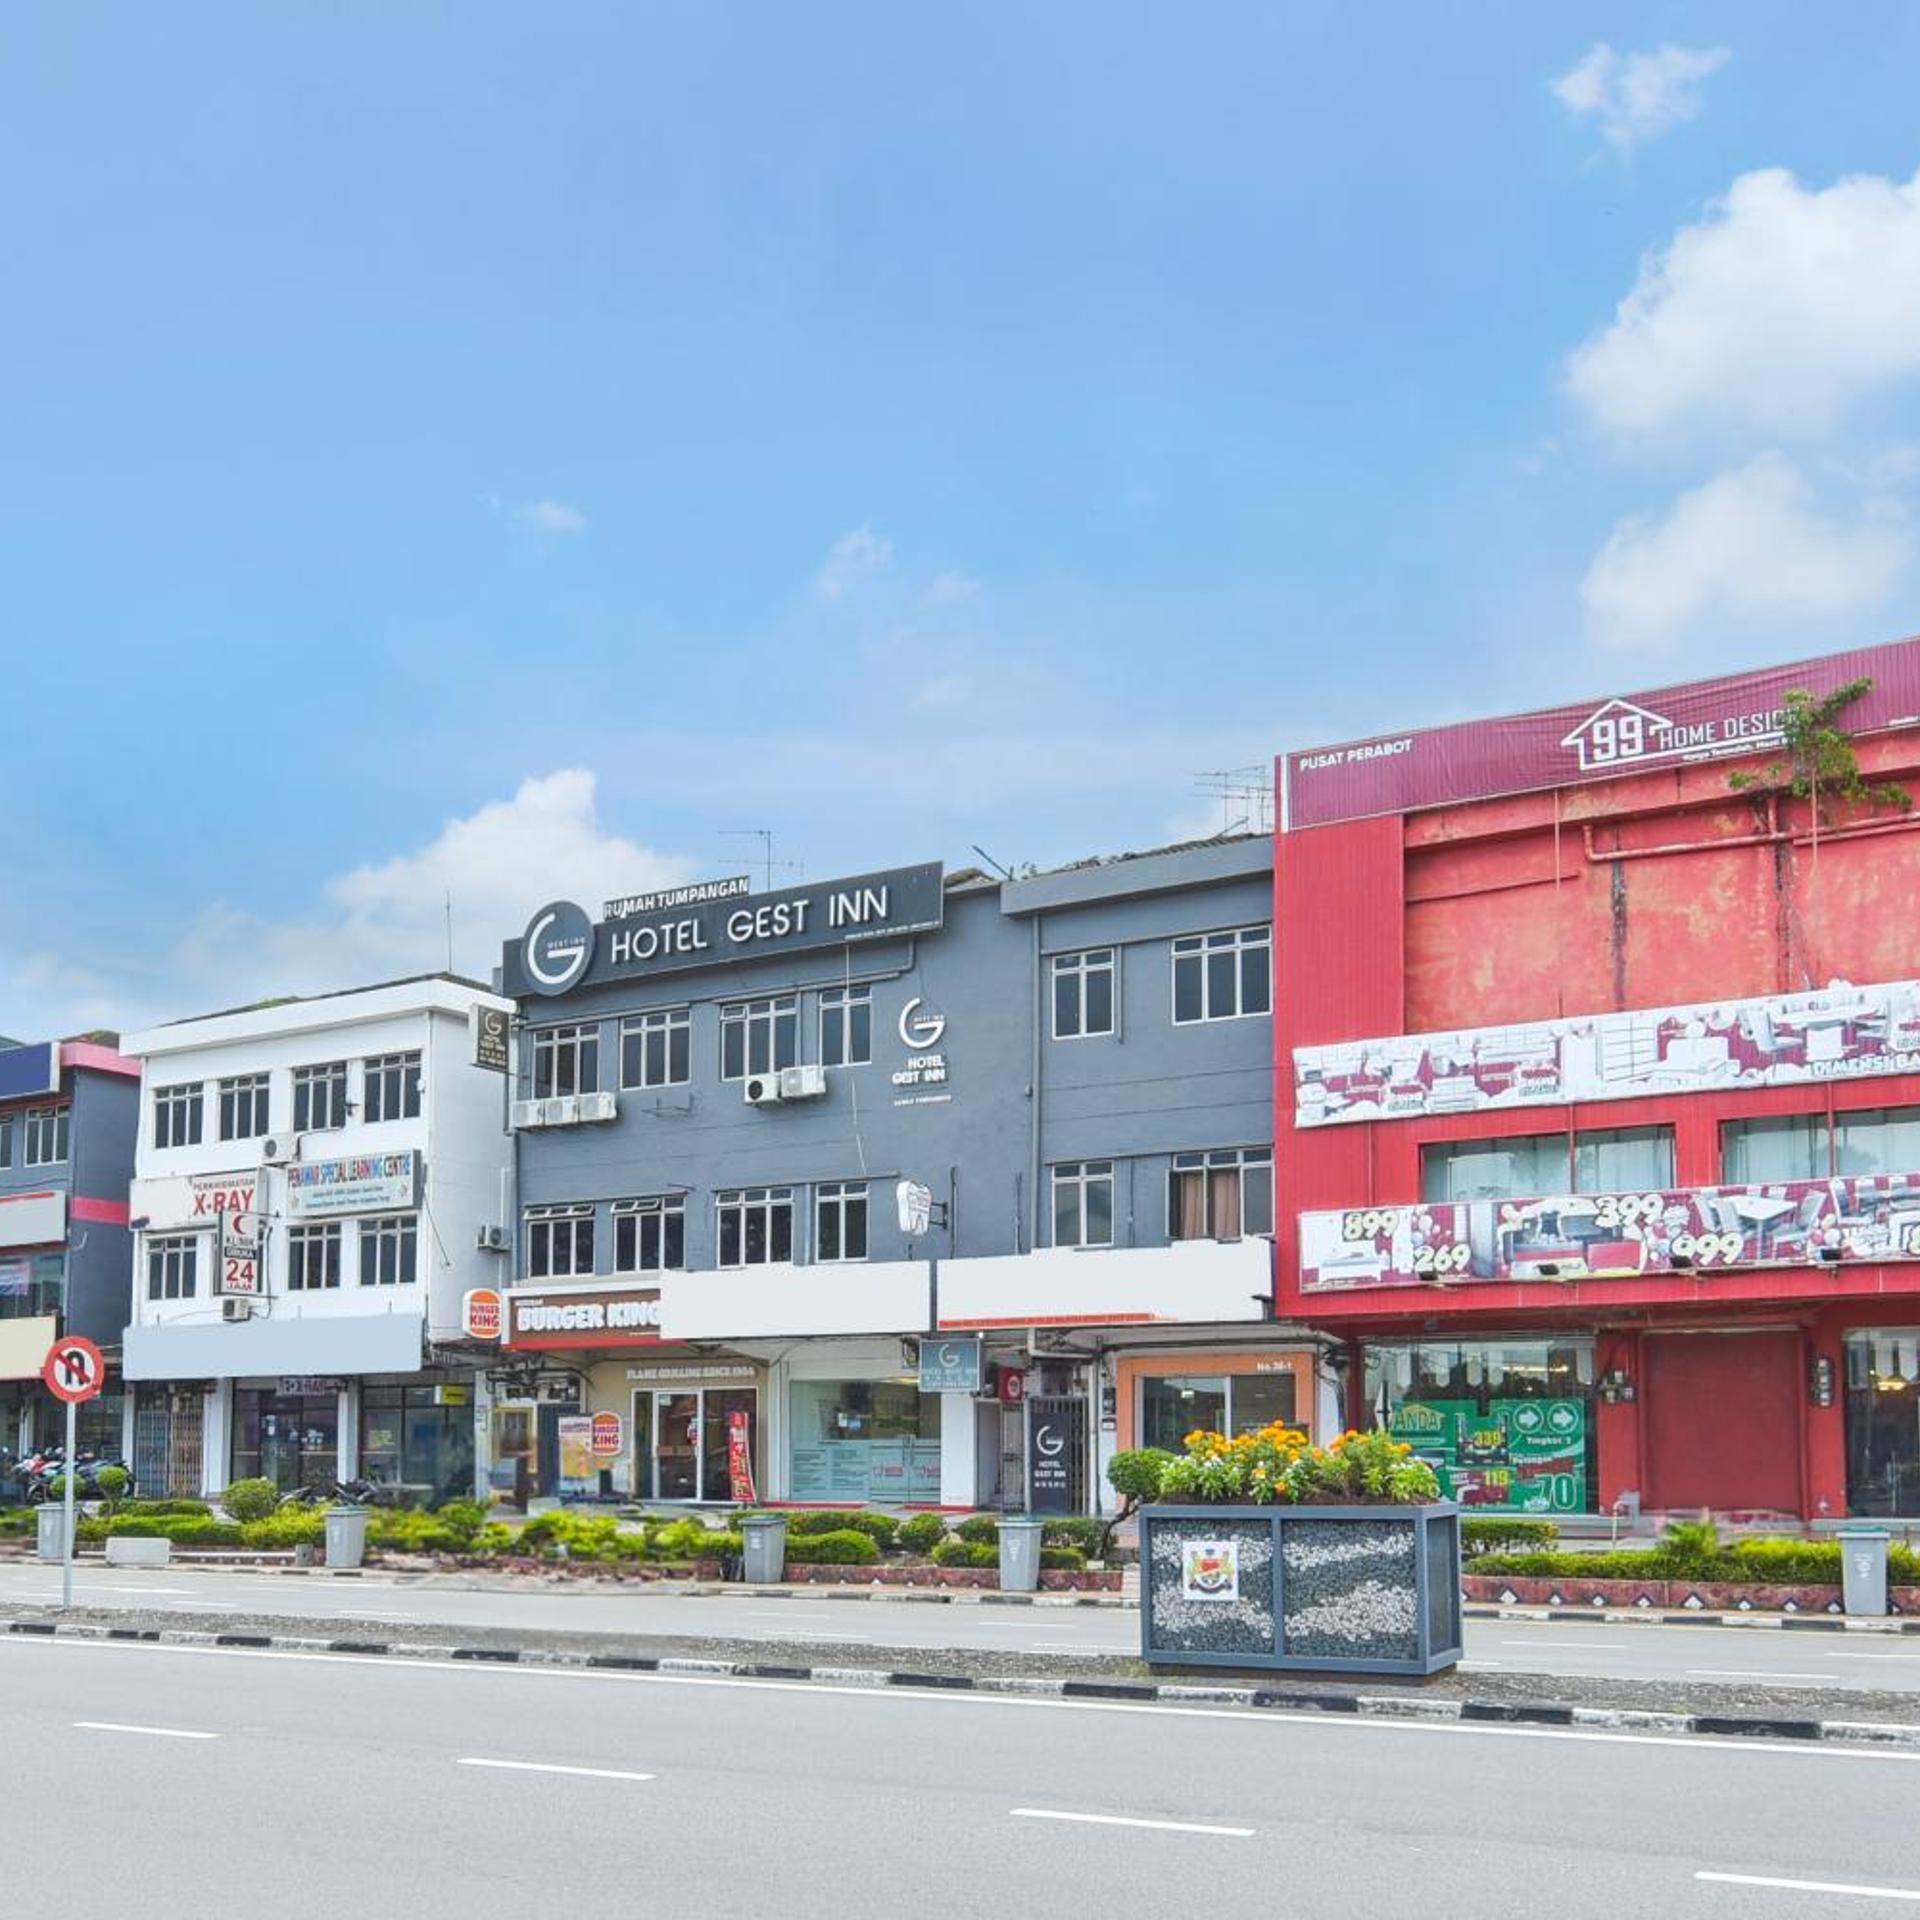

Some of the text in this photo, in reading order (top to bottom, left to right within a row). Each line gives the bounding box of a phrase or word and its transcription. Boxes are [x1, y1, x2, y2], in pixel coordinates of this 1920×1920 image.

[1593, 714, 1642, 760] 99
[1659, 720, 1716, 750] HOME
[1299, 738, 1413, 772] PUSAT PERABOT
[603, 879, 749, 919] RUMAH TUMPANGAN
[611, 918, 707, 963] HOTEL
[726, 900, 810, 943] GEST
[828, 885, 888, 927] INN
[908, 1055, 945, 1069] HOTEL
[892, 1069, 945, 1085] GEST INN
[193, 1189, 254, 1216] X-RAY
[1595, 1194, 1664, 1228] 399
[1343, 1210, 1399, 1241] 899
[226, 1259, 254, 1283] 24
[1414, 1244, 1471, 1273] 269
[470, 1314, 500, 1327] KING
[518, 1303, 605, 1331] BURGER
[592, 1434, 619, 1445] KING
